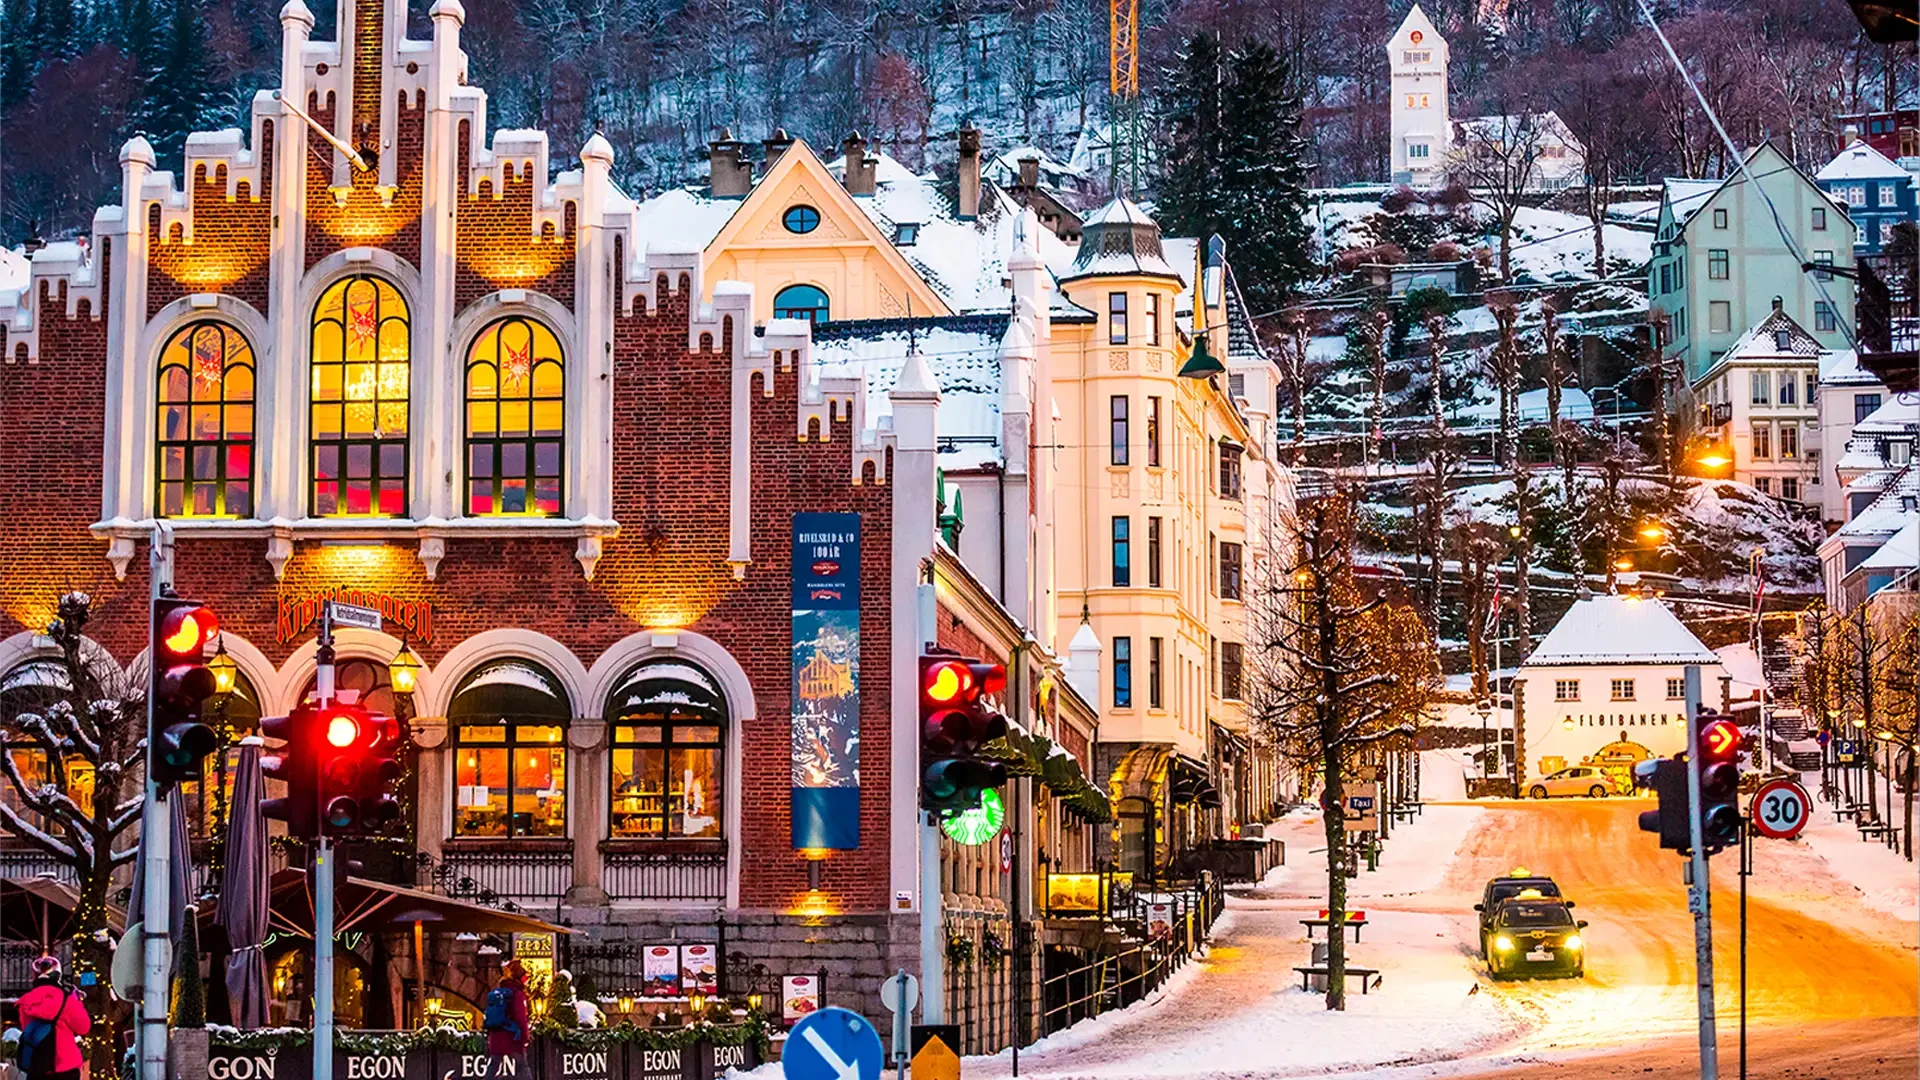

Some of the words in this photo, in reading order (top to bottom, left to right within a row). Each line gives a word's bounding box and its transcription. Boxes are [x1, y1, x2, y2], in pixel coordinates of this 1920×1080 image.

[838, 533, 844, 543] &
[845, 533, 855, 543] CO
[813, 546, 828, 558] 100
[1579, 714, 1667, 726] FLØIBANEN
[1842, 742, 1850, 753] P
[1353, 798, 1371, 808] Taxi
[1765, 795, 1799, 824] 30
[563, 1052, 607, 1075] EGON
[644, 1049, 681, 1071] EGON
[714, 1045, 745, 1066] EGON
[207, 1056, 276, 1079] GON
[347, 1055, 407, 1079] EGON
